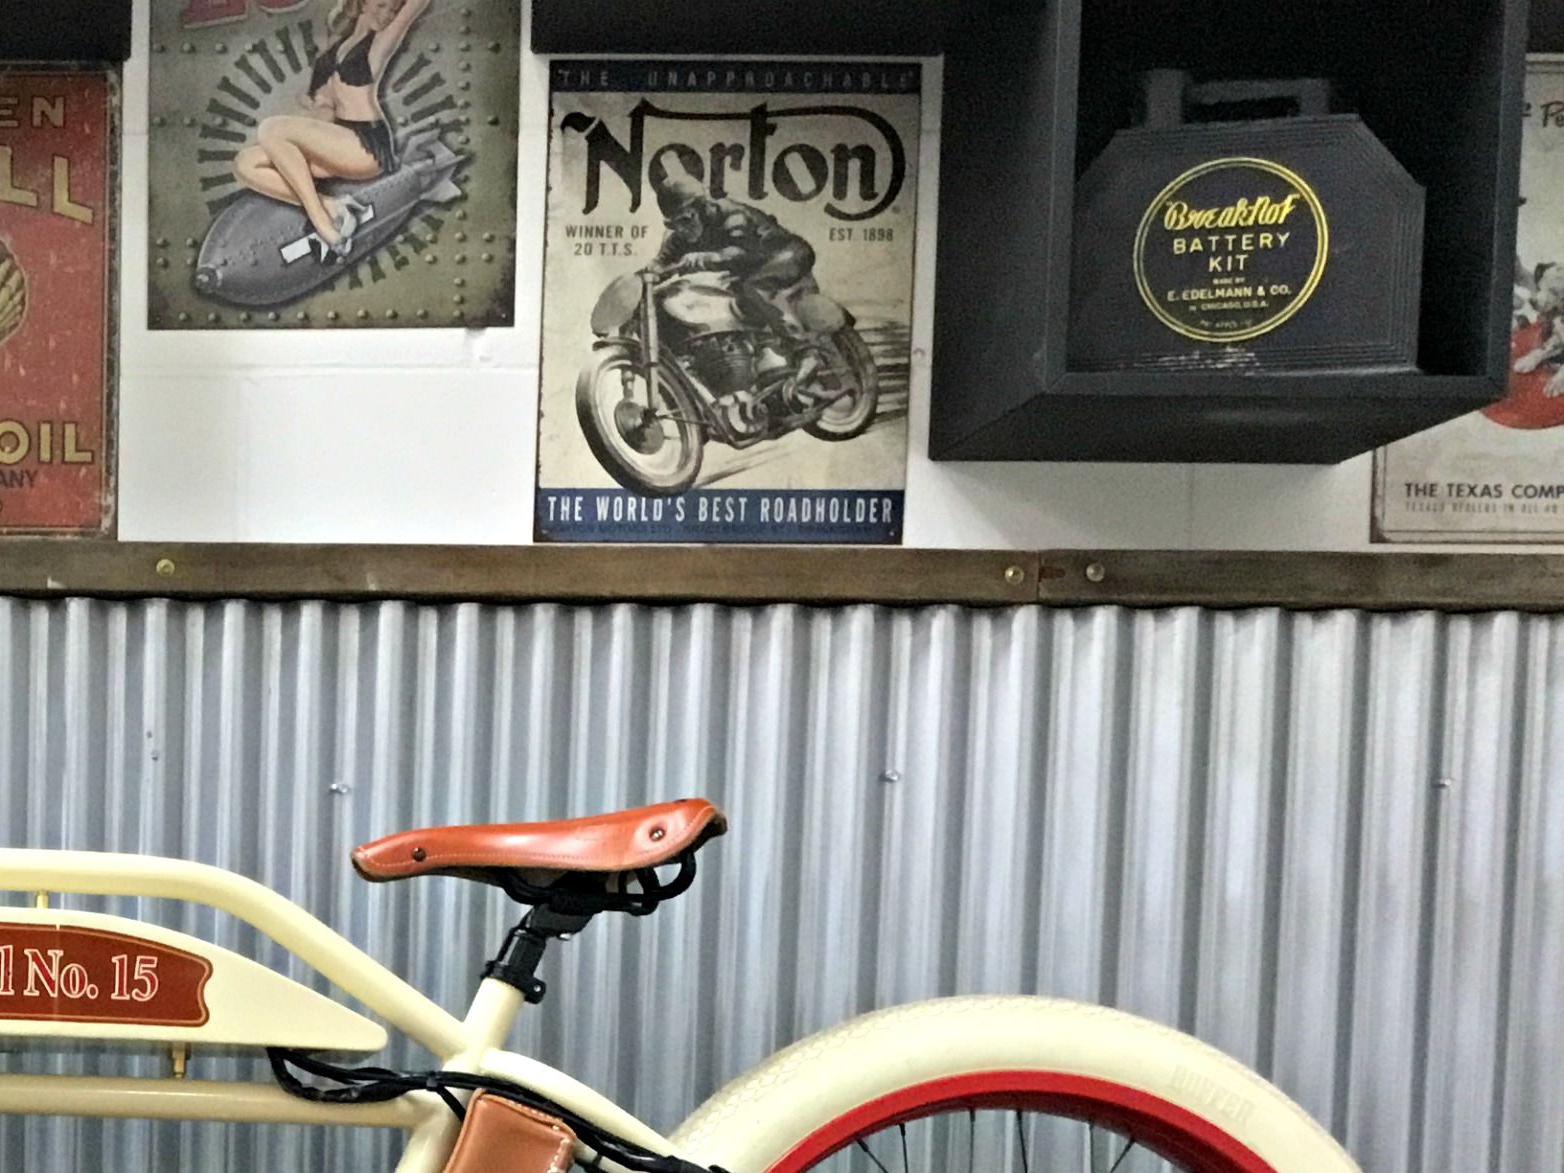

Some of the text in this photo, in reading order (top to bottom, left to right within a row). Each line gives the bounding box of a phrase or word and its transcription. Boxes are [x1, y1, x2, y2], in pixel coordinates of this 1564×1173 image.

[560, 97, 906, 221] Norton
[565, 225, 649, 239] WINNER OF
[863, 228, 894, 242] 1898
[574, 242, 593, 256] 20
[1173, 232, 1290, 255] BATTERY
[1209, 254, 1249, 272] KIT
[1182, 287, 1252, 301] EDELMANN
[1257, 285, 1265, 297] &
[1270, 284, 1292, 295] CO.
[1405, 483, 1439, 498] THE
[1447, 484, 1503, 499] TEXAS
[548, 496, 893, 523] THE WORLD'S BEST ROADHOLDER
[23, 948, 99, 1000] No.
[110, 954, 159, 1001] 15
